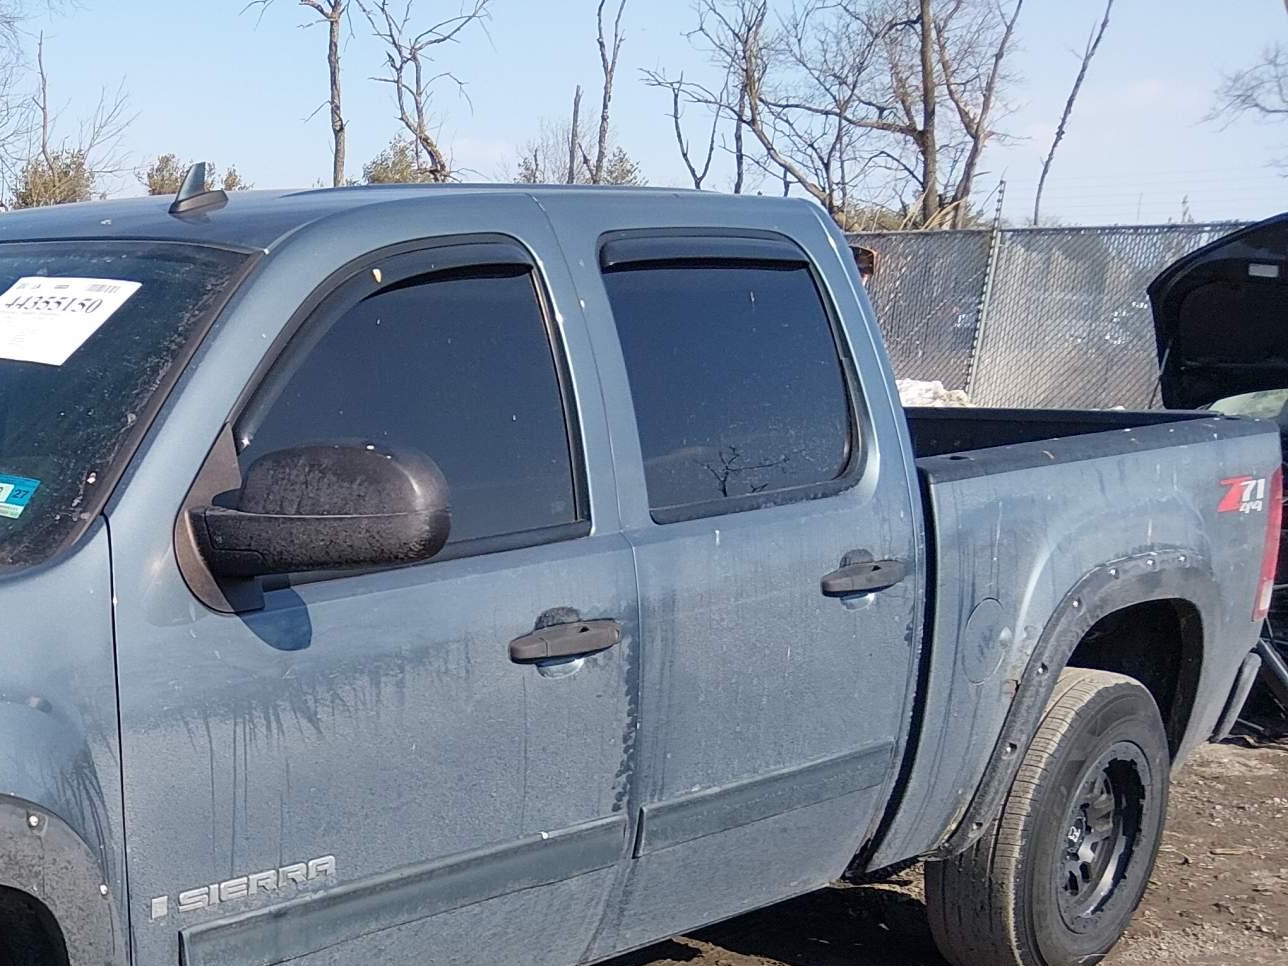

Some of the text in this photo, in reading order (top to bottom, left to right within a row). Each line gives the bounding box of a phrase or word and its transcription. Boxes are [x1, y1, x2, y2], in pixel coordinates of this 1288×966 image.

[4, 295, 104, 313] 44355150
[12, 488, 30, 499] 27
[1216, 475, 1266, 513] Z71
[178, 854, 336, 913] SIERRA
